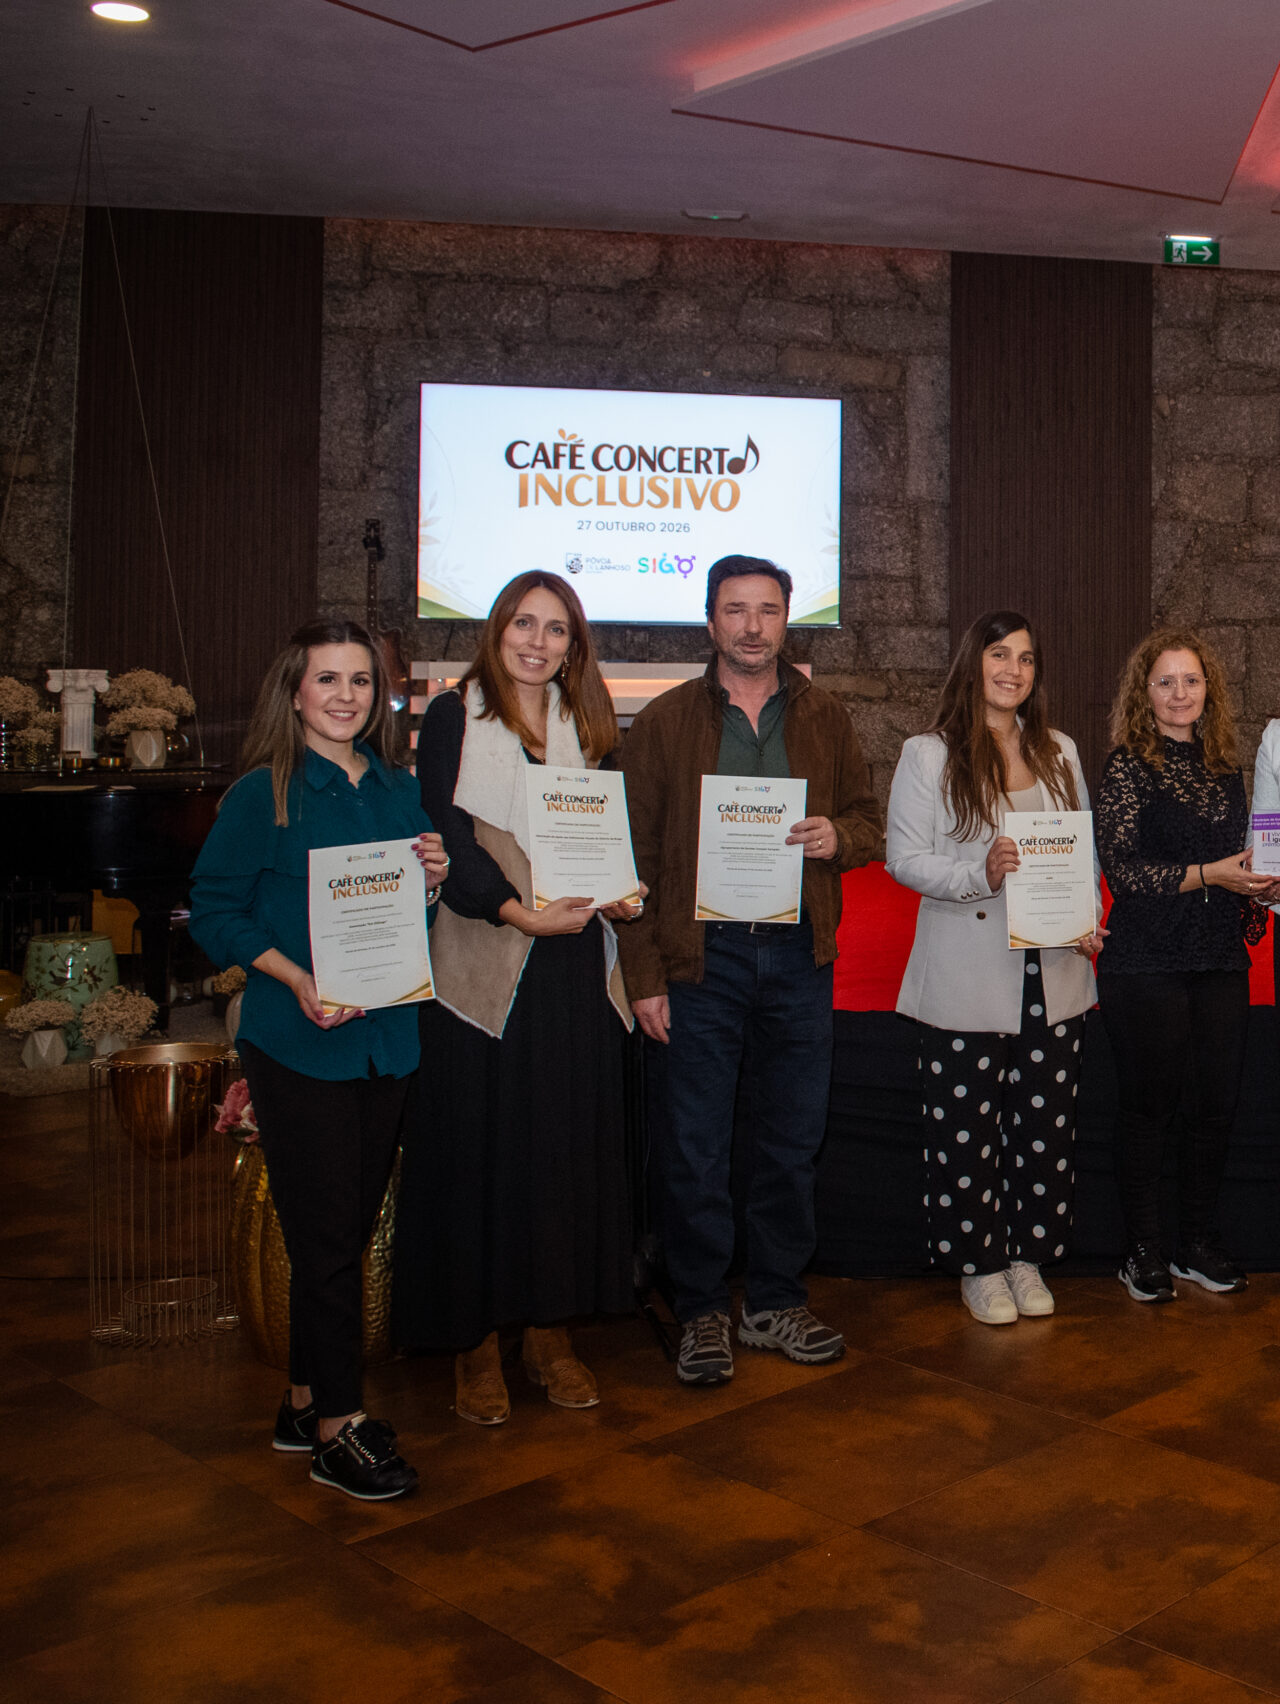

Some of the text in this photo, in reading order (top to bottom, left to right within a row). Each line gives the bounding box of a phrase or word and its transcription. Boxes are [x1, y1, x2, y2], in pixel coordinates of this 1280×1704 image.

[504, 438, 585, 470] CAFÉ
[518, 473, 741, 512] INCLUSIVO
[577, 520, 691, 533] 27 OUTUBRO 2026
[547, 802, 605, 814] INCLUSIVO
[720, 812, 782, 825] INCLUSIVO
[1022, 845, 1074, 856] INCLUSIVO
[332, 881, 400, 900] INCLUSIVO
